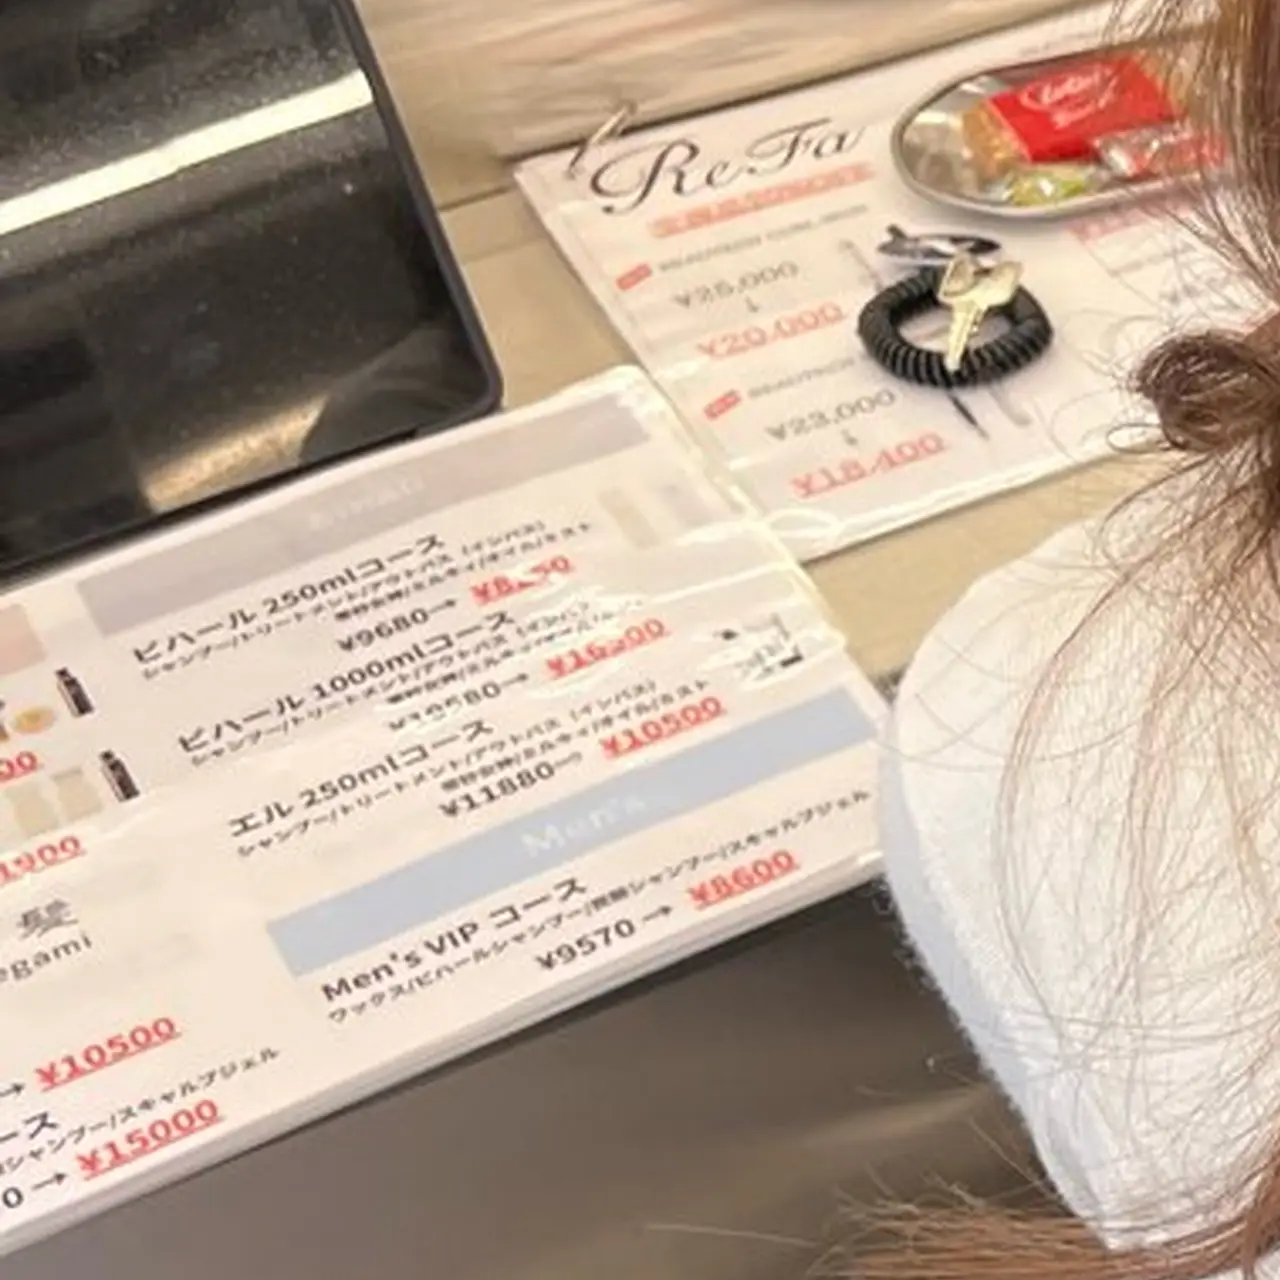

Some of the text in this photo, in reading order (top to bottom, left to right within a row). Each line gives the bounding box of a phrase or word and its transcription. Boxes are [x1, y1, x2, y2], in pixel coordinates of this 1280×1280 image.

[590, 116, 866, 215] ReFa
[133, 610, 257, 664] ビハール
[337, 608, 428, 651] ¥9680
[179, 694, 305, 752] ビハール
[440, 696, 728, 818] ¥11880 ¥10500
[229, 801, 295, 838] エル
[321, 876, 588, 1003] Men's VIP コース
[535, 848, 801, 971] ¥9570 ¥8600
[33, 1016, 183, 1093] ¥10500
[77, 1099, 225, 1182] ¥15000
